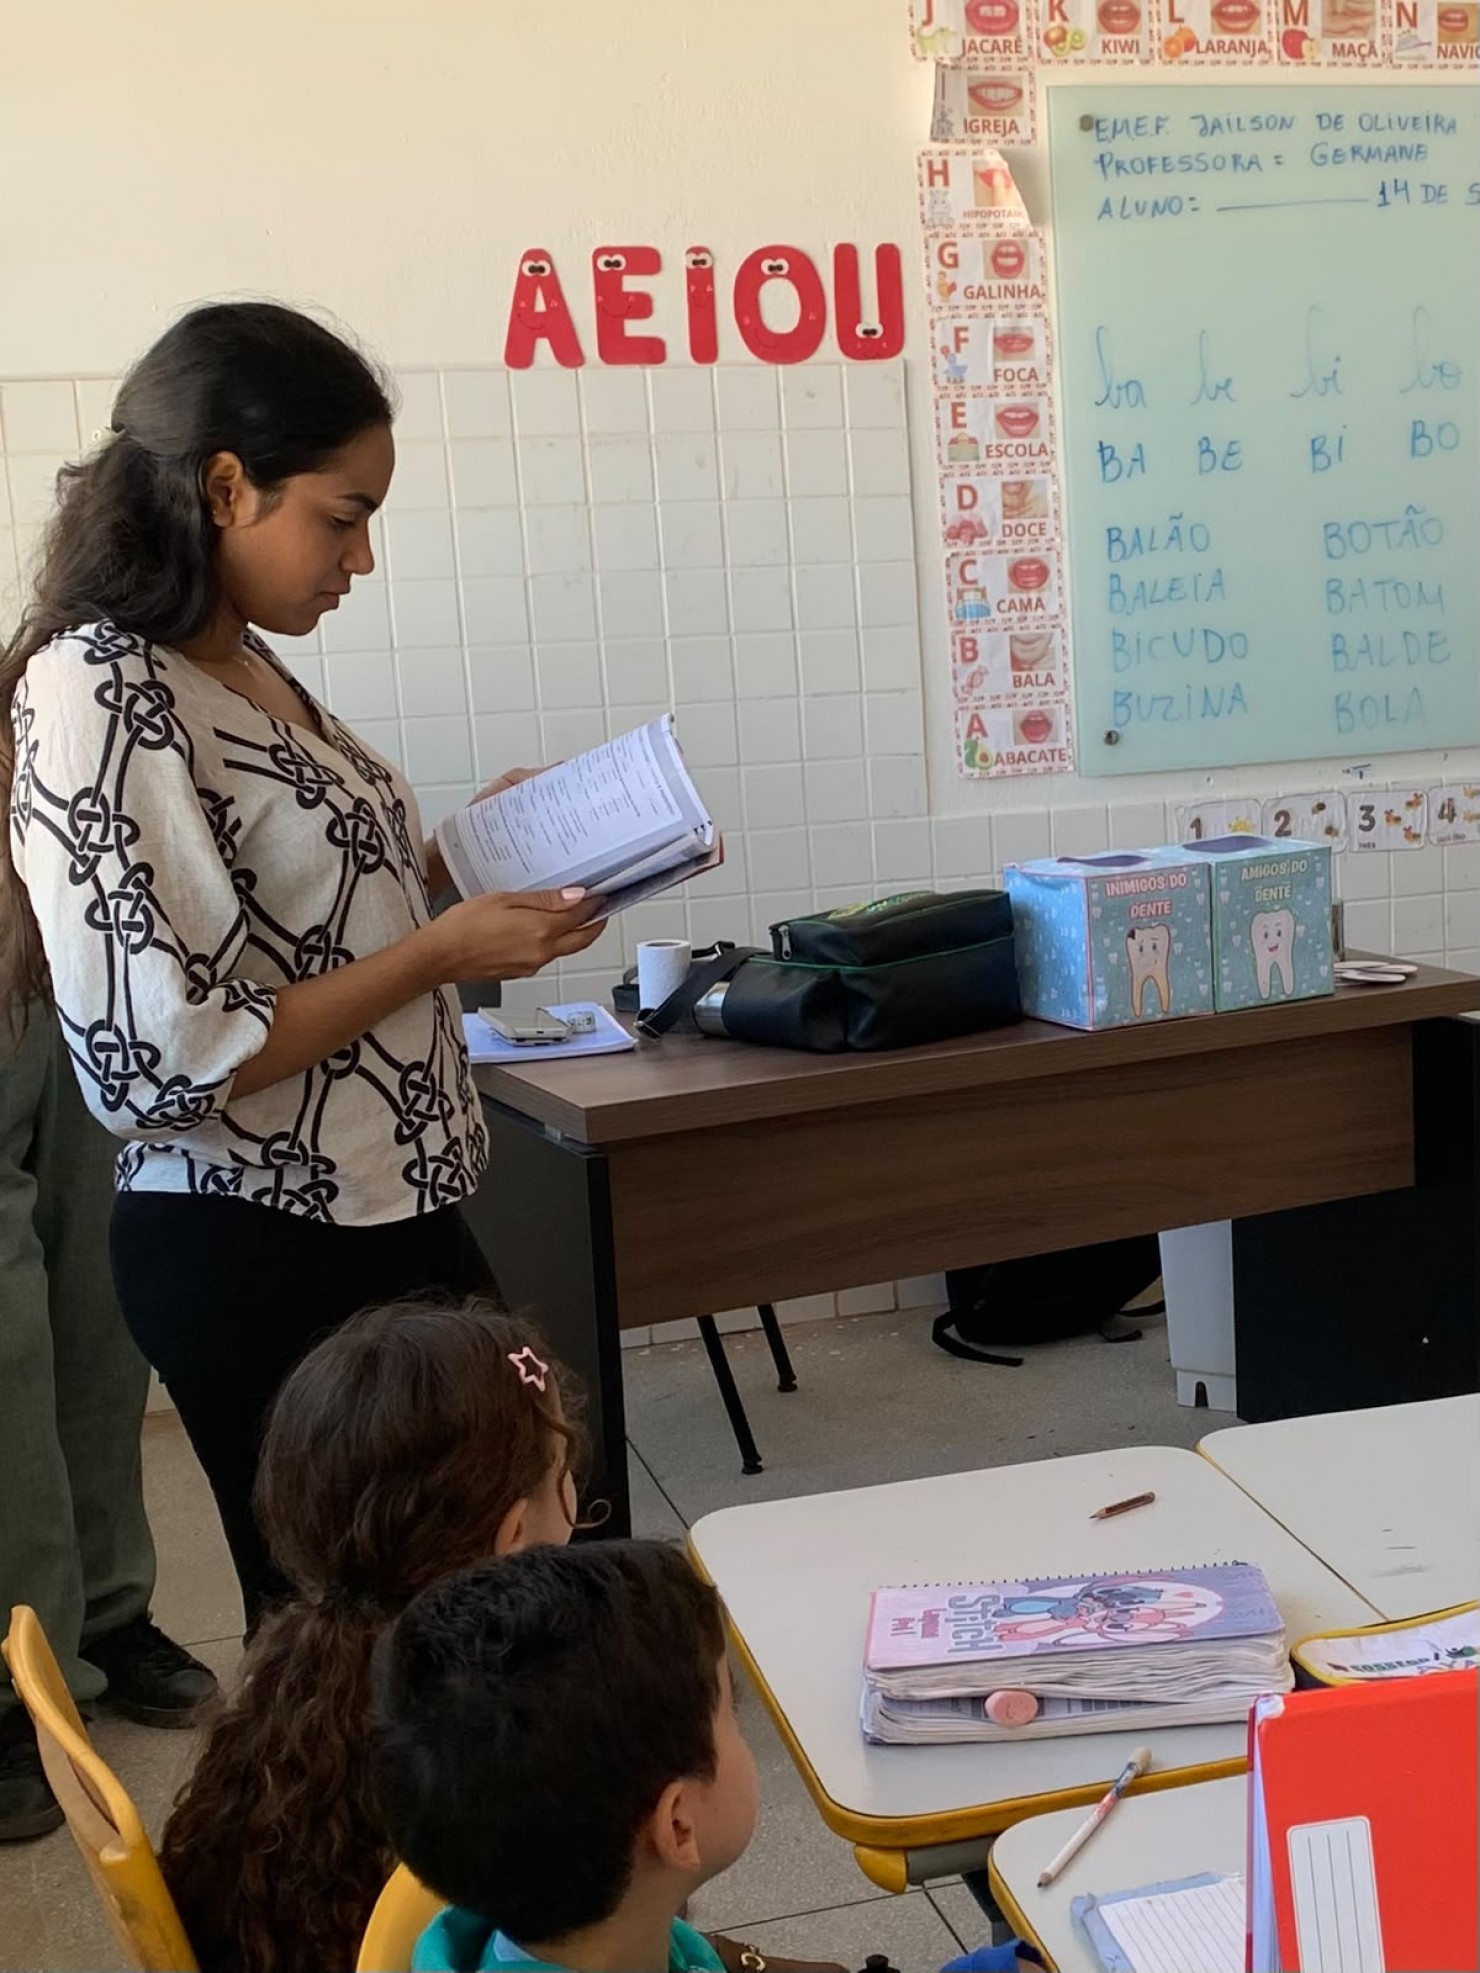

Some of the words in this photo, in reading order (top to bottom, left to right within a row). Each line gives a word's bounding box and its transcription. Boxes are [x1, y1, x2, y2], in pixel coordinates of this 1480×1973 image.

[921, 0, 934, 27] J
[1048, 0, 1070, 23] K
[1170, 0, 1185, 24] L
[1283, 0, 1310, 26] M
[1396, 1, 1418, 28] N
[961, 37, 1023, 58] JACARÉ
[1101, 39, 1140, 54] KIWI
[1196, 39, 1267, 58] LARANJA
[1332, 41, 1378, 61] MAÇÃ
[963, 117, 1020, 138] IGREJA
[1315, 111, 1346, 133] DE
[1358, 111, 1458, 136] OLIVEIRA
[927, 159, 950, 188] H
[1094, 151, 1263, 182] PROFESSORA
[1310, 141, 1429, 166] GERMANE
[1377, 177, 1411, 208] 14
[1420, 182, 1449, 206] DE
[937, 242, 961, 269] G
[963, 284, 1040, 301] GALINHA
[953, 325, 970, 353] F
[1094, 325, 1148, 410] ba
[1189, 328, 1239, 406] be
[1289, 304, 1345, 398] bi
[1399, 305, 1464, 395] bo
[993, 367, 1039, 384] FOCA
[951, 402, 967, 429] E
[985, 442, 1049, 459] ESCOLA
[1098, 440, 1147, 483] BA
[1198, 436, 1243, 476] BE
[1310, 424, 1349, 474] BI
[1410, 419, 1461, 459] BO
[957, 484, 978, 510] D
[1001, 521, 1047, 538] DOCE
[1105, 511, 1210, 562] BALÃO
[1323, 504, 1444, 560] BOTÃO
[958, 558, 978, 586] C
[1108, 568, 1226, 616] BALEIA
[1326, 577, 1446, 615] BATOM
[996, 597, 1045, 614] CAMA
[960, 637, 979, 664] B
[1111, 626, 1249, 673] BICUDO
[1331, 629, 1451, 672] BALDE
[1012, 672, 1056, 688] BALA
[1113, 681, 1248, 728] BUZINA
[1334, 686, 1427, 734] BOLA
[965, 711, 988, 739] A
[994, 746, 1067, 767] ABACATE
[1273, 809, 1292, 838] 2
[1357, 804, 1376, 833] 3
[1437, 797, 1457, 824] 4
[1189, 817, 1203, 839] 1
[1240, 862, 1289, 882] AMIGOS
[1290, 858, 1308, 874] DO
[1105, 873, 1167, 898] INIMIGOS
[1169, 872, 1188, 889] DO
[1254, 884, 1292, 902] DENTE
[1129, 899, 1173, 919] DENTE
